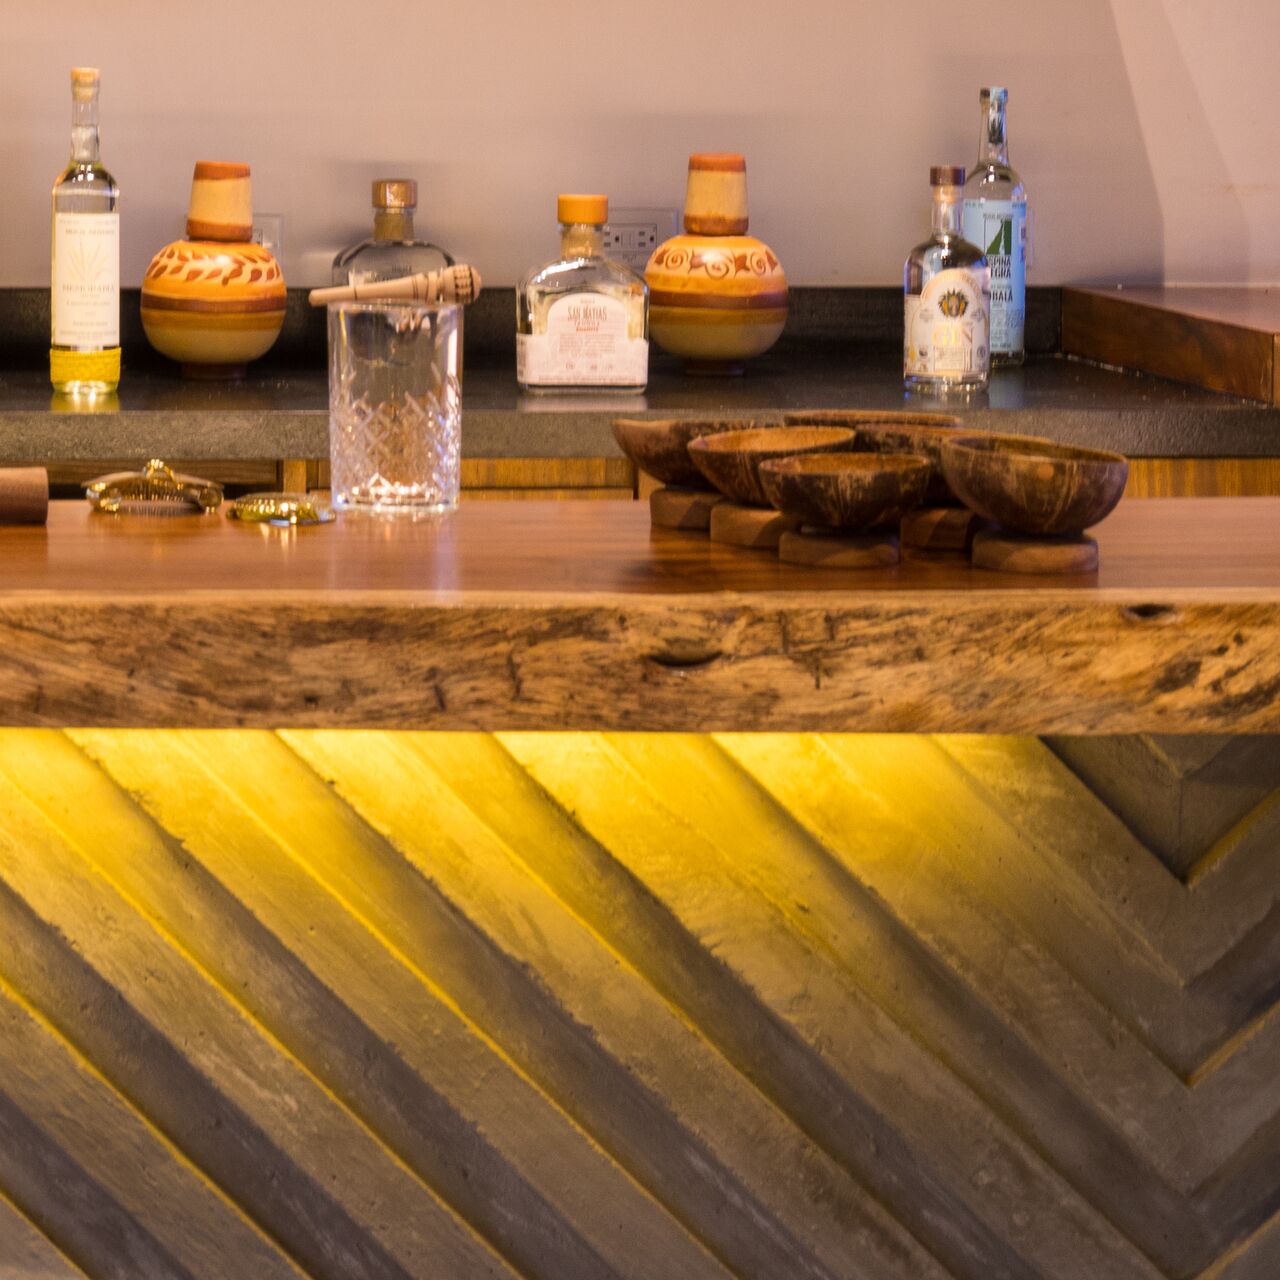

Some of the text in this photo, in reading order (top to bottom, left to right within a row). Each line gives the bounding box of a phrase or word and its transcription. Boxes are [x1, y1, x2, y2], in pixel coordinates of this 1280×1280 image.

[988, 256, 1011, 267] SPINA
[991, 268, 1011, 279] EGRA
[567, 306, 581, 321] SAN
[931, 326, 974, 346] GIN
